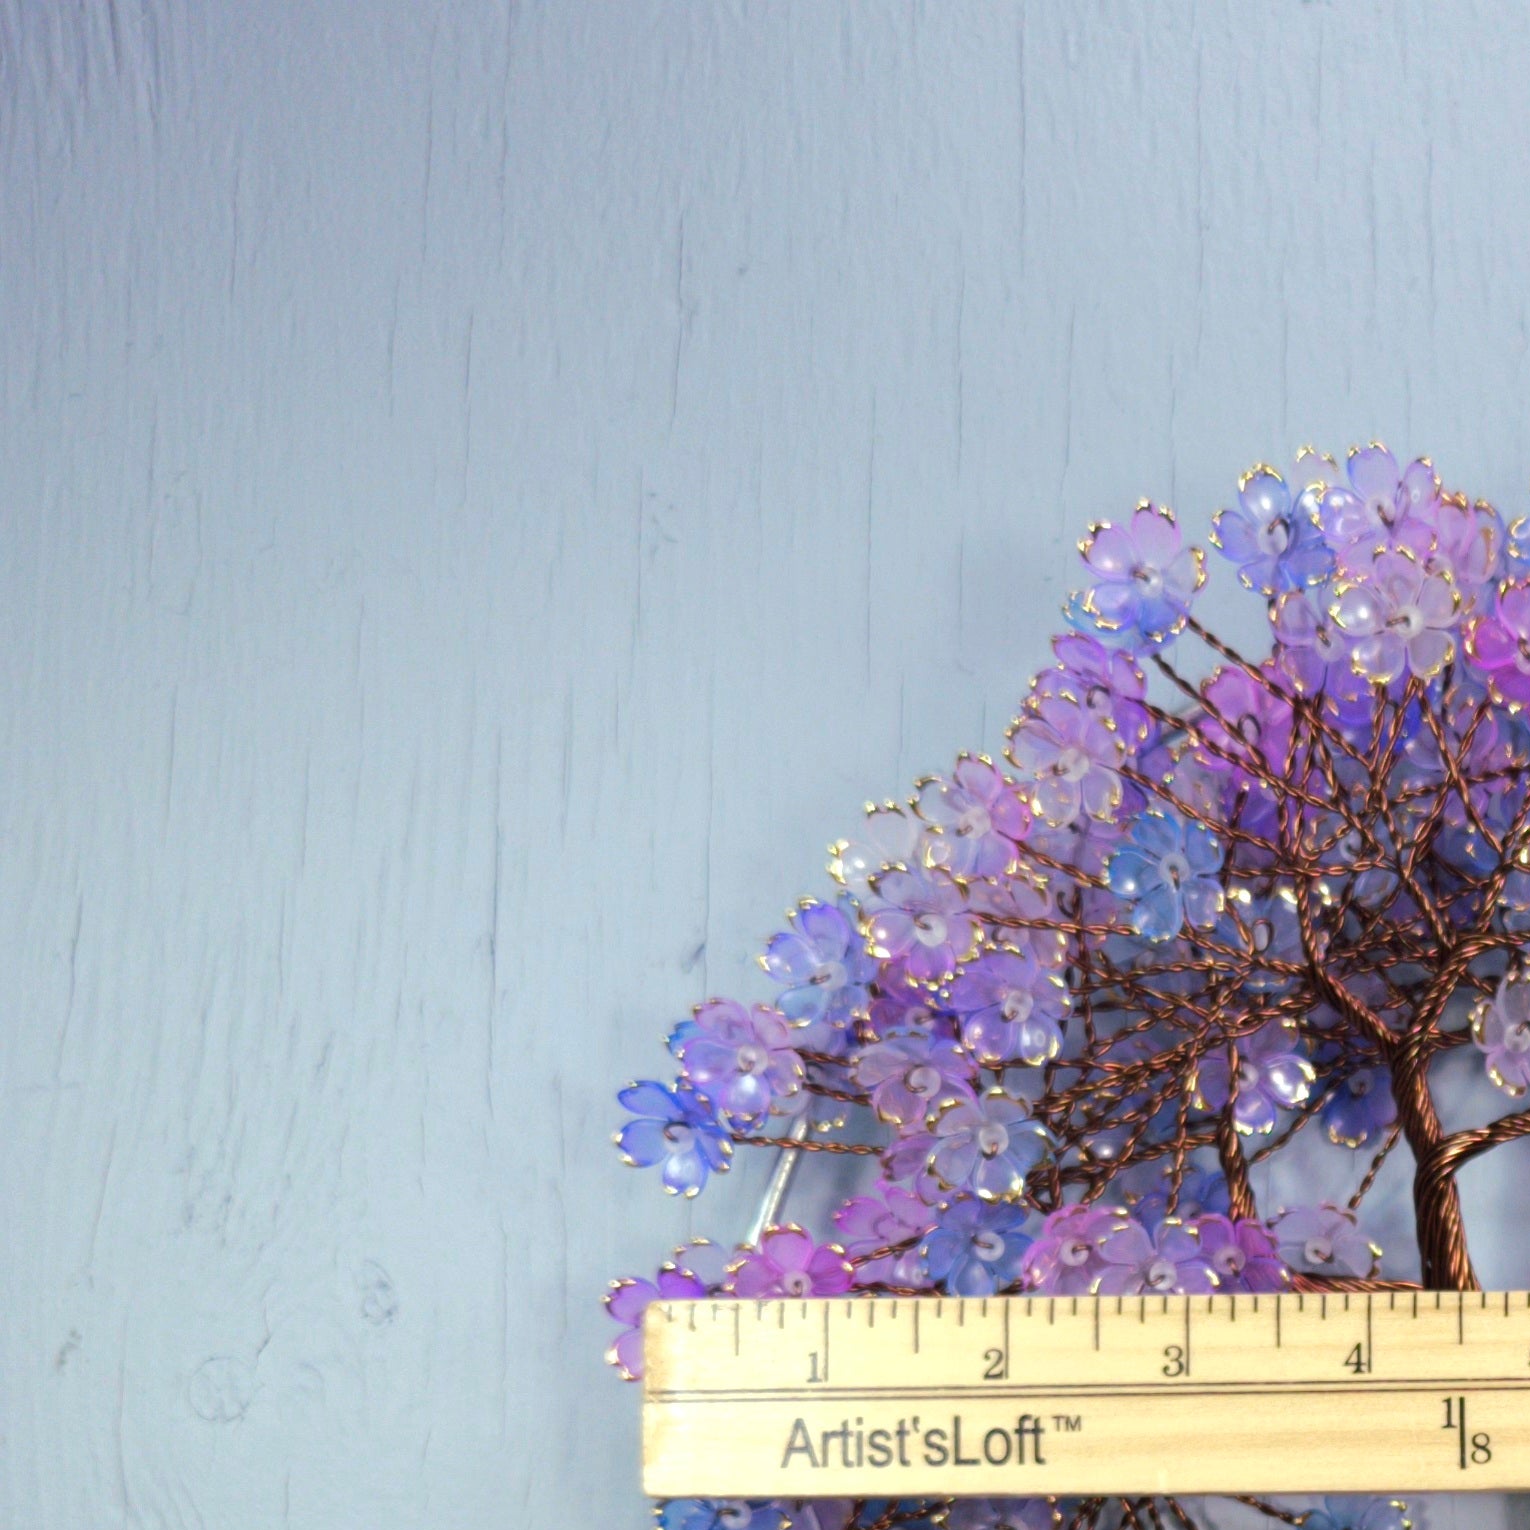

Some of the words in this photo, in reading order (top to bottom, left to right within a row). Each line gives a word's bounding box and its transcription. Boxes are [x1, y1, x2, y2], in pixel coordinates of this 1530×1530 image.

[806, 1352, 823, 1383] 1
[983, 1348, 1005, 1380] 2
[1163, 1345, 1185, 1377] 3
[1344, 1342, 1368, 1374] 4
